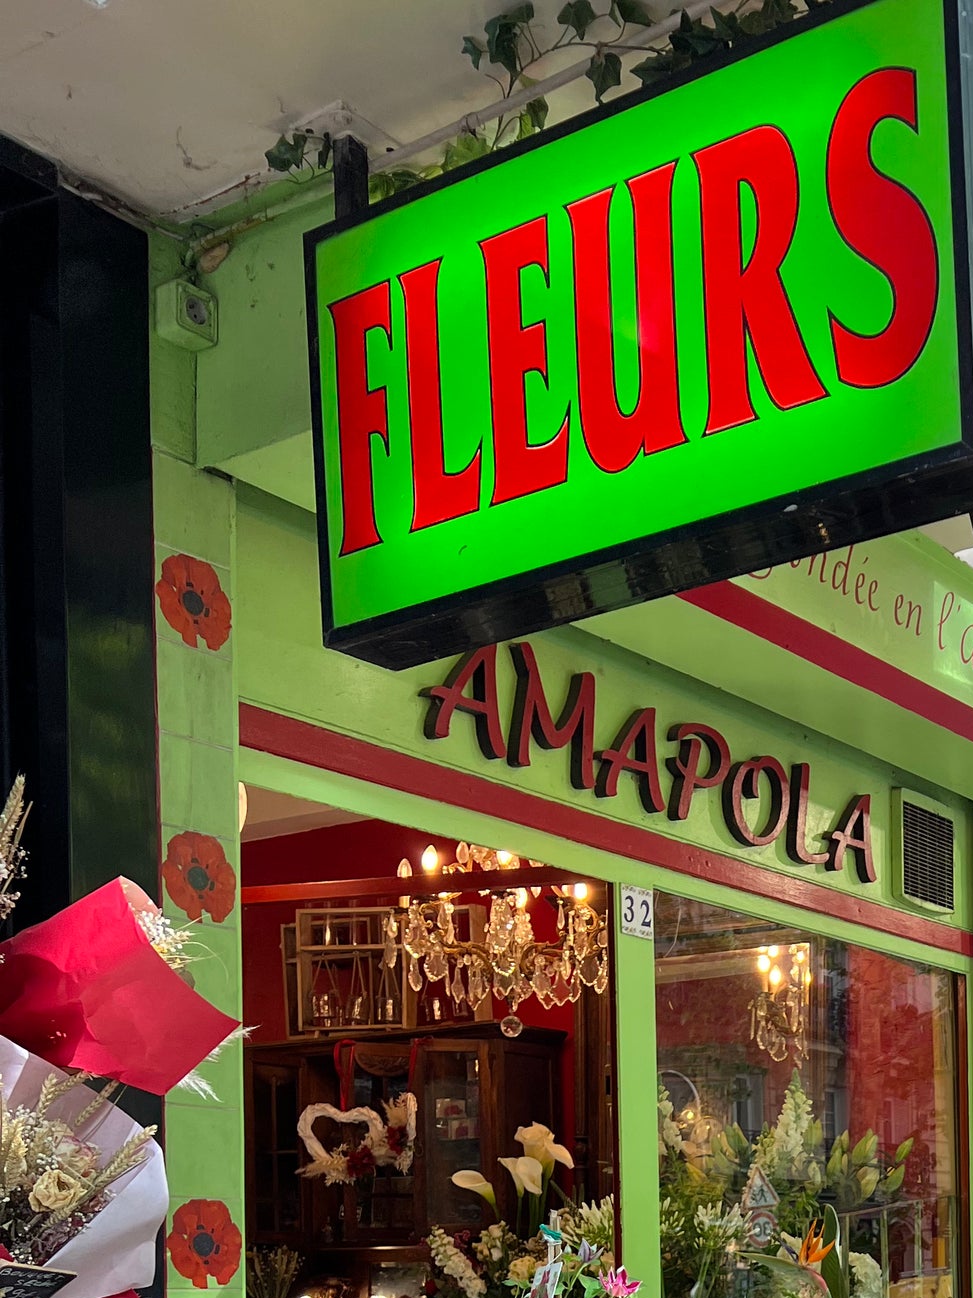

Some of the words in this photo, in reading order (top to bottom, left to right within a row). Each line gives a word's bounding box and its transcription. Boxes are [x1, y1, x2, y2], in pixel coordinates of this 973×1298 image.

[326, 66, 940, 558] FLEURS
[894, 594, 922, 636] en
[418, 641, 878, 884] AMAPOLA
[623, 895, 652, 928] 32
